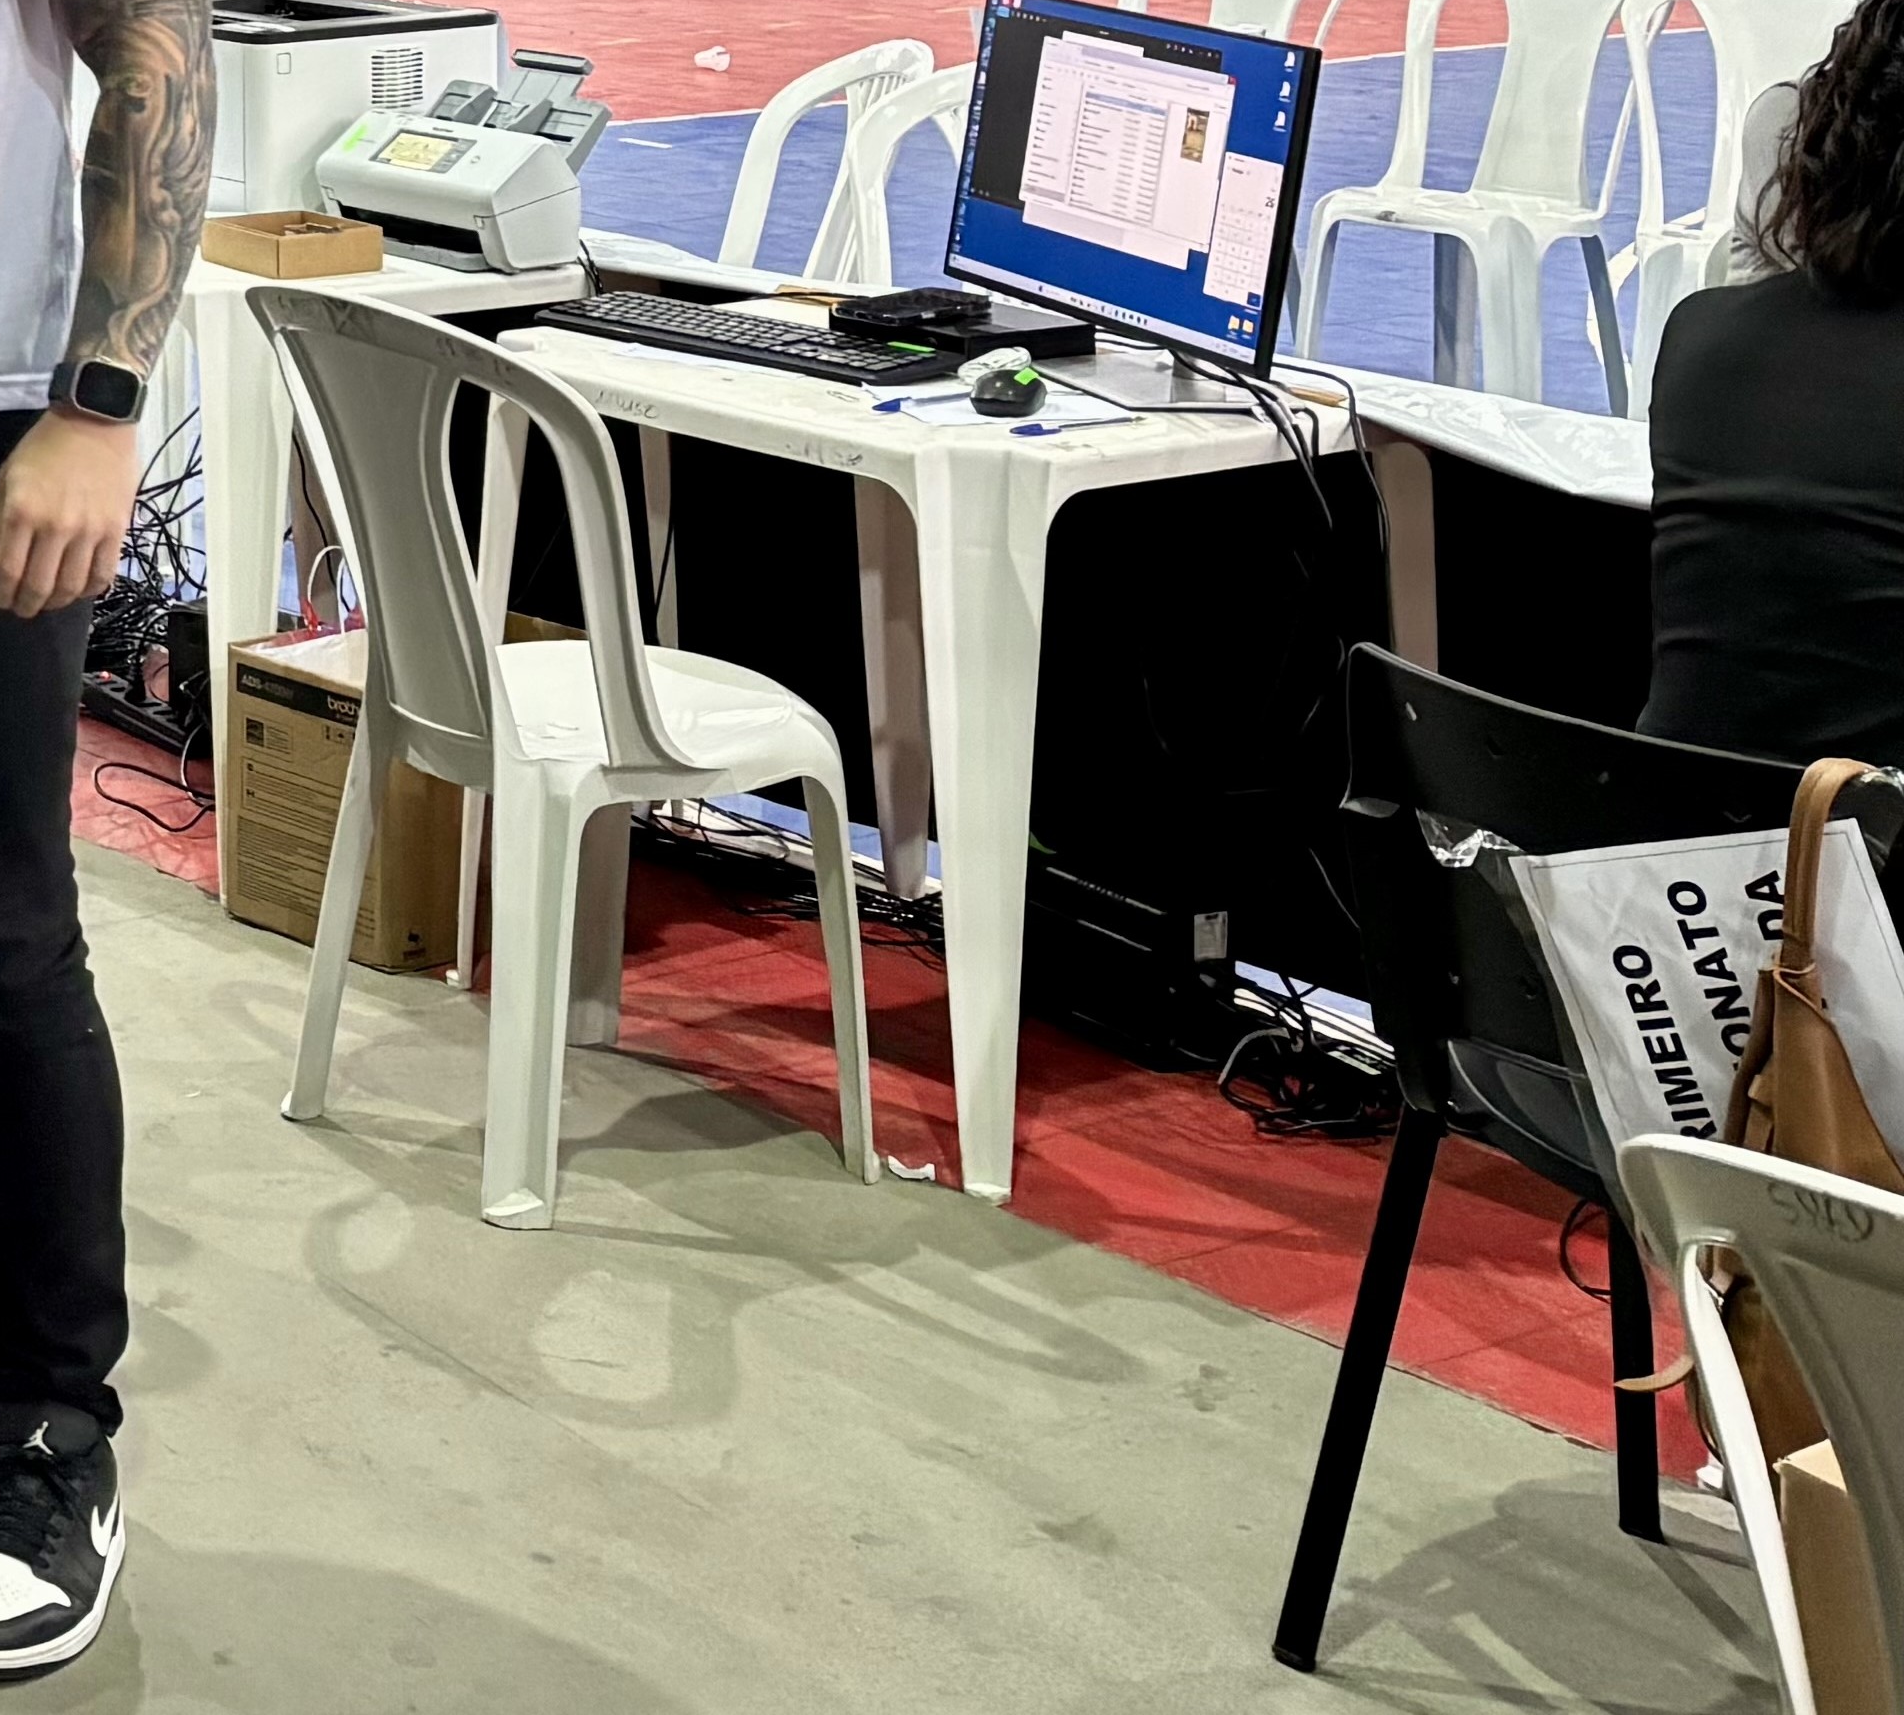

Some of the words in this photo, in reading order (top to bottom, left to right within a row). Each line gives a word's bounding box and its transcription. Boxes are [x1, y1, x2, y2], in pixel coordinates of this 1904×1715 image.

[327, 694, 359, 715] broth
[1612, 944, 1718, 1141] RIMEIRO
[1667, 880, 1752, 1071] ONATO
